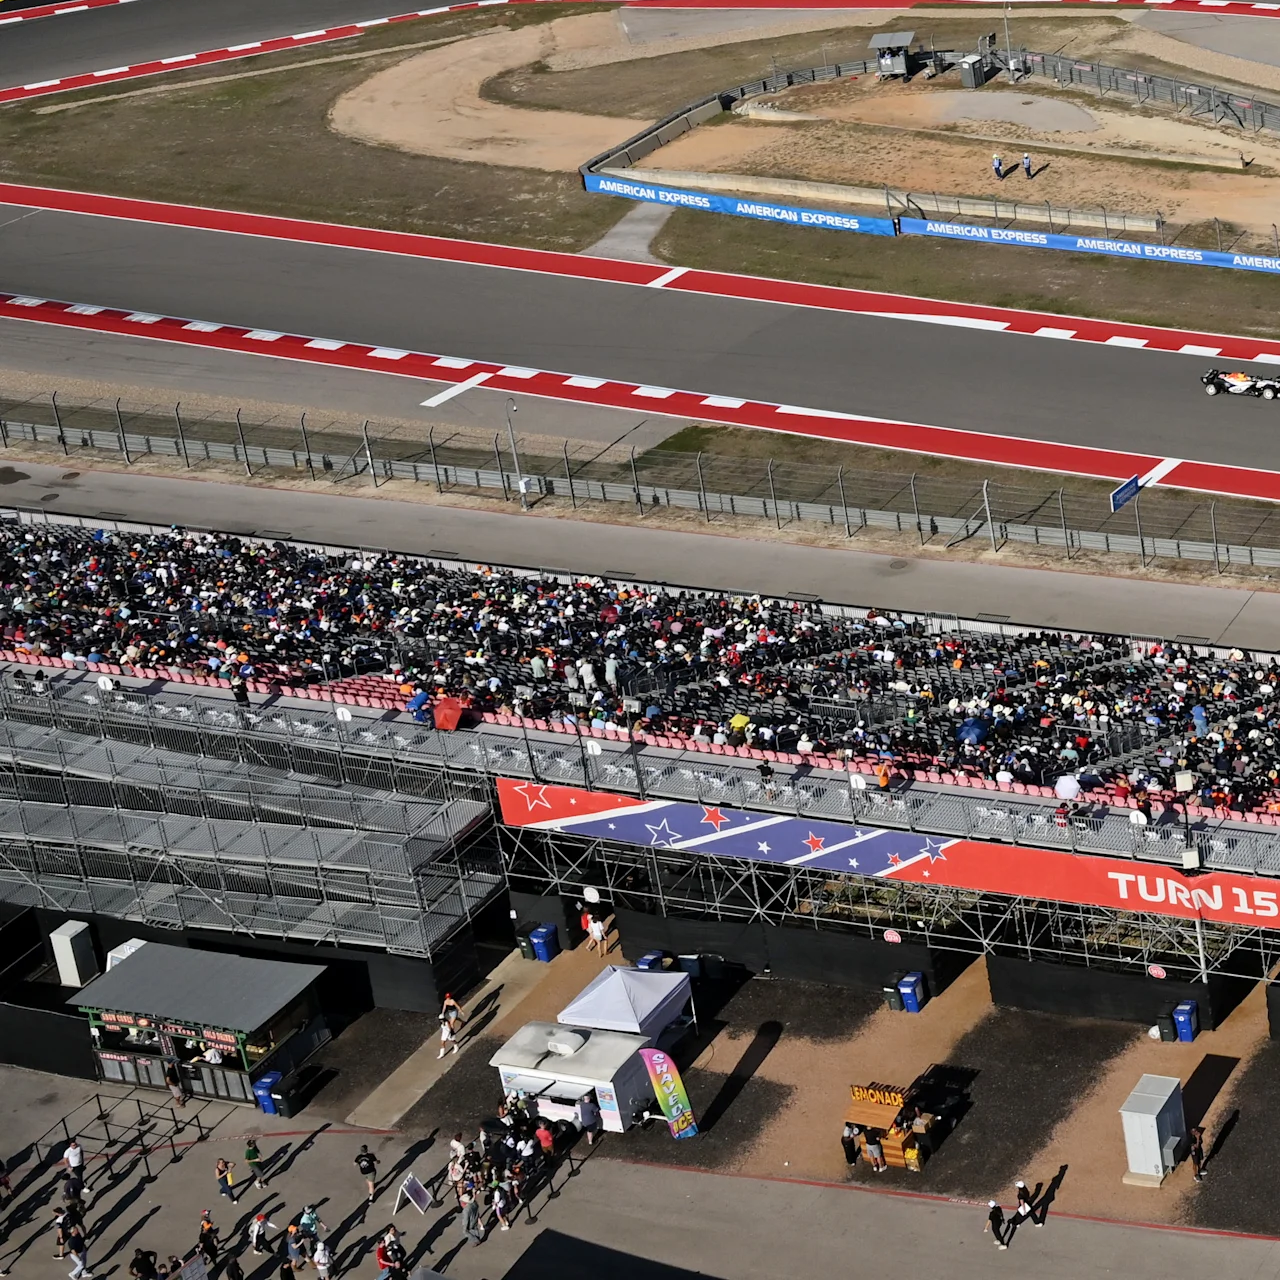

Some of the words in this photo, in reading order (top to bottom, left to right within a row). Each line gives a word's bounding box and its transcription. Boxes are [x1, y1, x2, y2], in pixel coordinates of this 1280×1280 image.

[600, 180, 655, 199] AMERICAN
[659, 192, 710, 207] EXPRESS
[737, 203, 797, 221] AMERICAN
[801, 213, 859, 228] EXPRESS
[927, 223, 988, 237] AMERICAN
[991, 230, 1047, 244] EXPRESS
[1077, 239, 1141, 254] AMERICAN
[1145, 246, 1202, 260] EXPRESS
[1108, 872, 1223, 912] TURN
[1232, 887, 1278, 917] 15
[652, 1052, 684, 1116] SHAVED
[673, 1110, 694, 1133] ICE
[850, 1085, 904, 1108] LEMONADE
